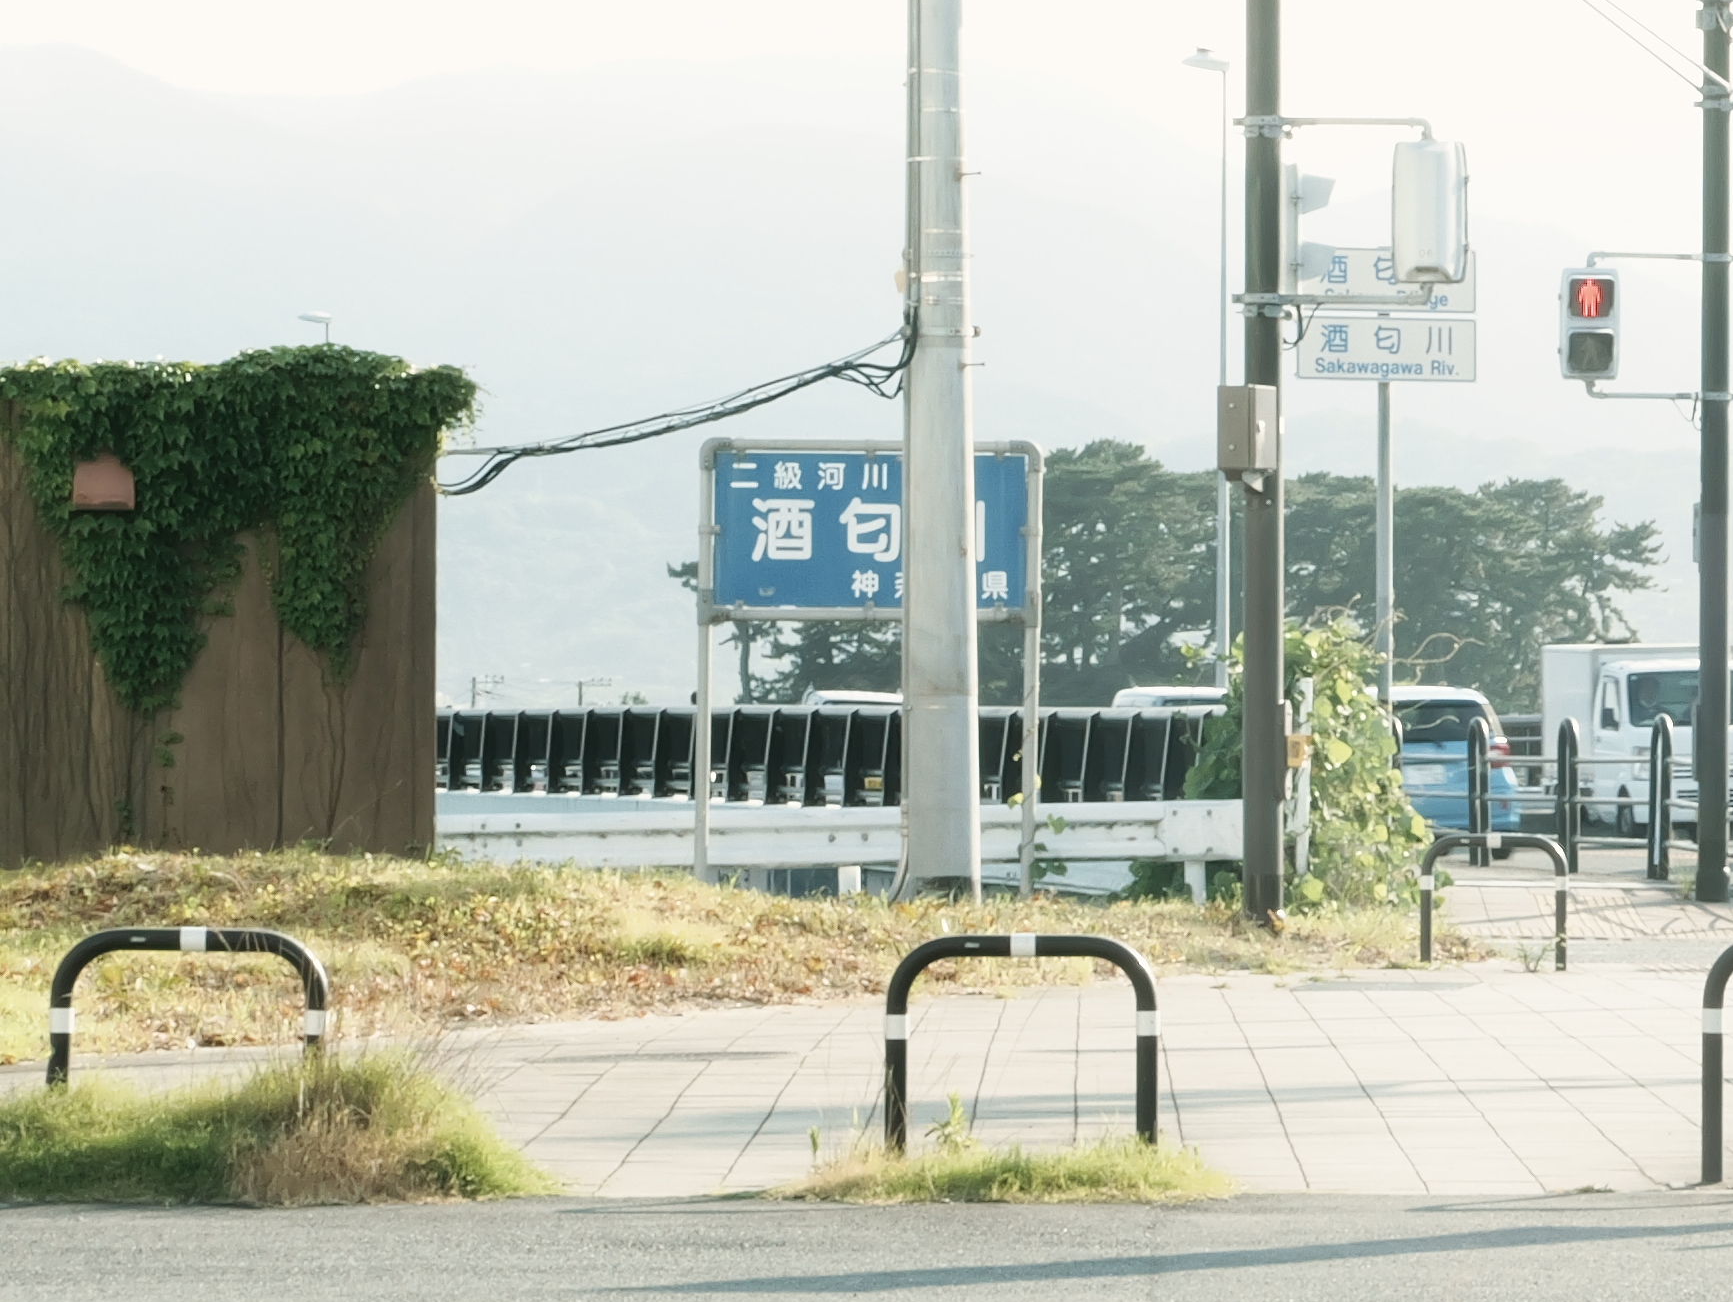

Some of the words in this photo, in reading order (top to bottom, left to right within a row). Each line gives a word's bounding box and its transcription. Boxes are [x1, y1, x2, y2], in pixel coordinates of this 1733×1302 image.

[1320, 255, 1398, 285] 酒匂
[1320, 324, 1453, 355] 酒匂川
[1314, 357, 1424, 378] Sakawagawa
[1430, 359, 1460, 377] Riv.
[729, 460, 889, 491] 二級河川
[851, 569, 1009, 601] 神県
